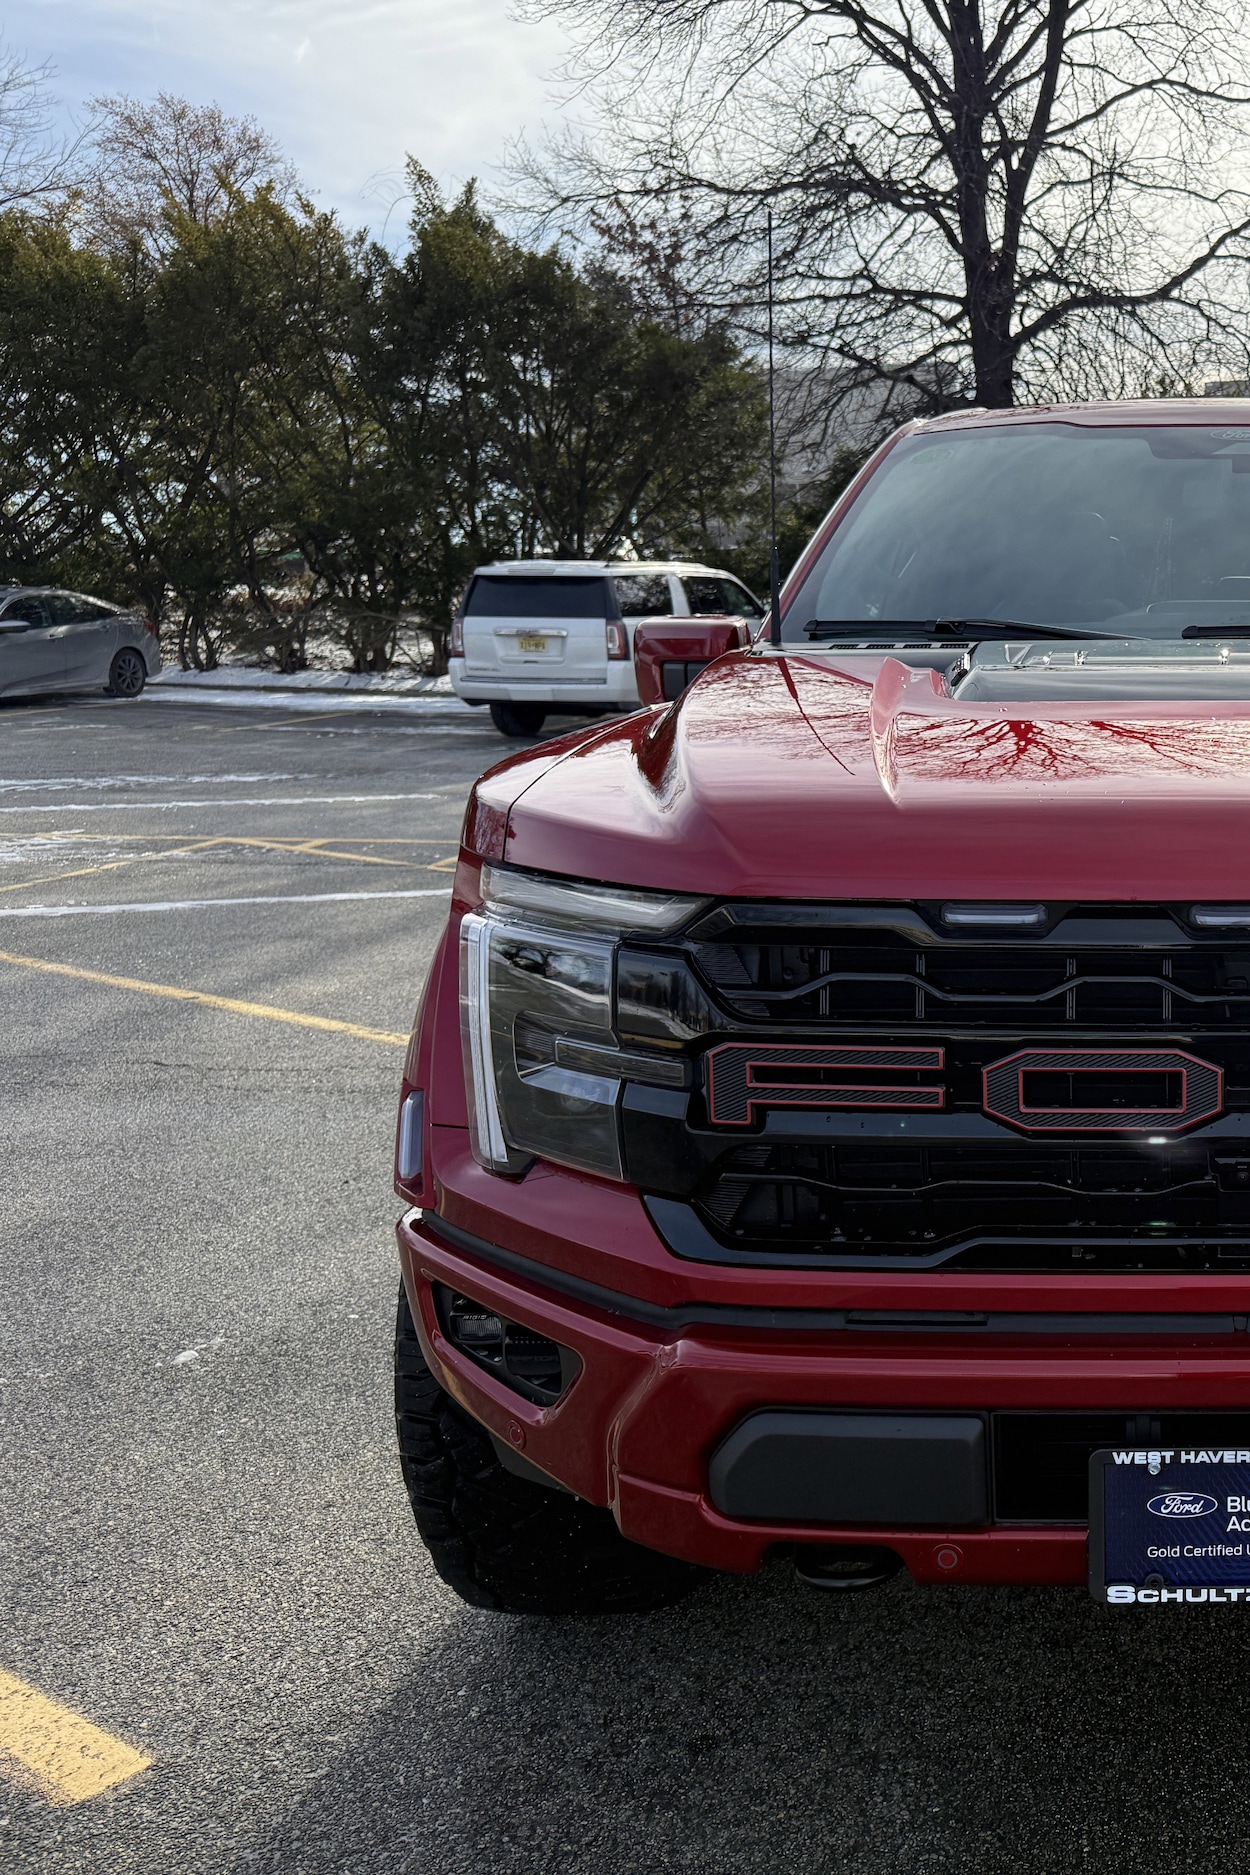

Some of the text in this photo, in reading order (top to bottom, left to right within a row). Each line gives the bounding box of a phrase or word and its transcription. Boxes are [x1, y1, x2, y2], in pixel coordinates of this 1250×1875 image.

[1112, 1451, 1175, 1465] WEST
[1160, 1495, 1205, 1515] Ford
[1147, 1545, 1181, 1558] Gold
[1183, 1544, 1243, 1557] Certified
